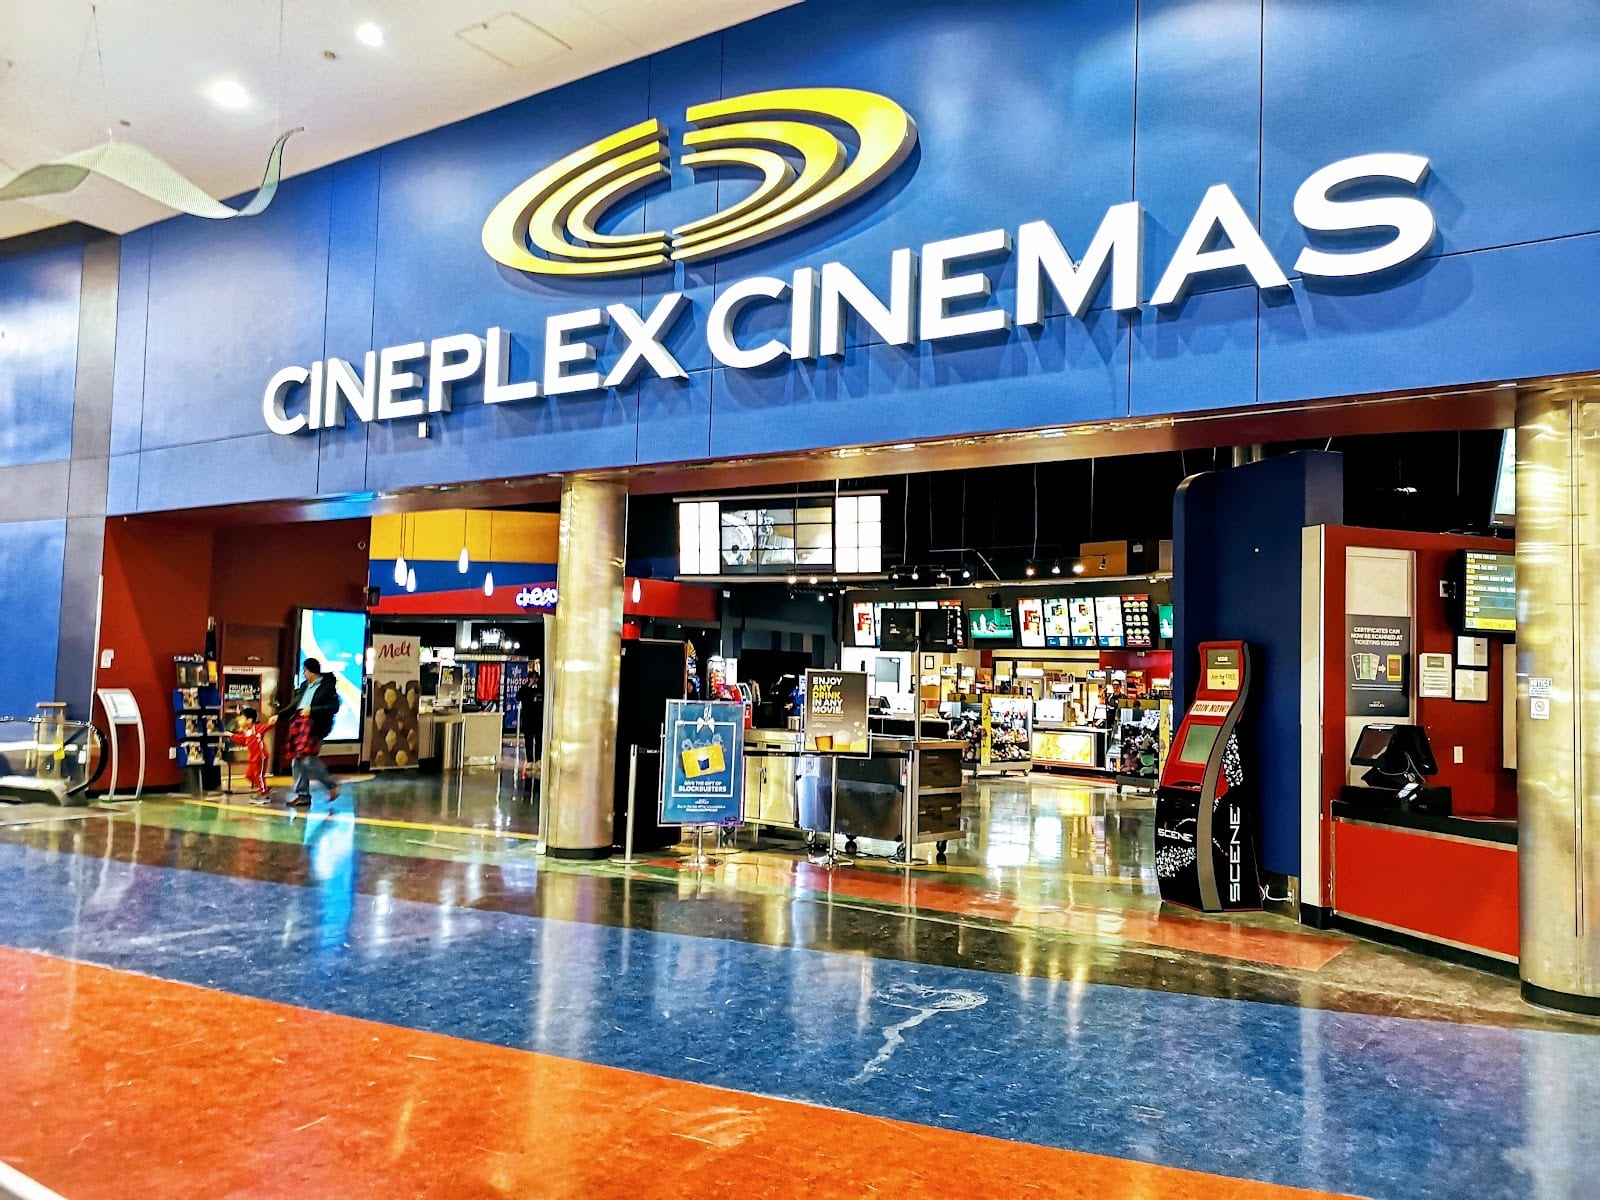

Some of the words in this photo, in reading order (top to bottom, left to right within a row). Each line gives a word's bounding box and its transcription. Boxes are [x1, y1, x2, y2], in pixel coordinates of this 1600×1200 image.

[262, 292, 690, 436] CINEPLEX
[706, 152, 1436, 369] CINEMAS
[379, 641, 411, 659] Melt
[812, 677, 842, 685] ENJOY
[812, 684, 832, 692] ANY
[812, 691, 841, 700] DRINK
[823, 699, 843, 707] ANY
[812, 706, 844, 714] MOVIE.
[1157, 828, 1193, 842] SCENE
[1229, 805, 1241, 903] SCENE
